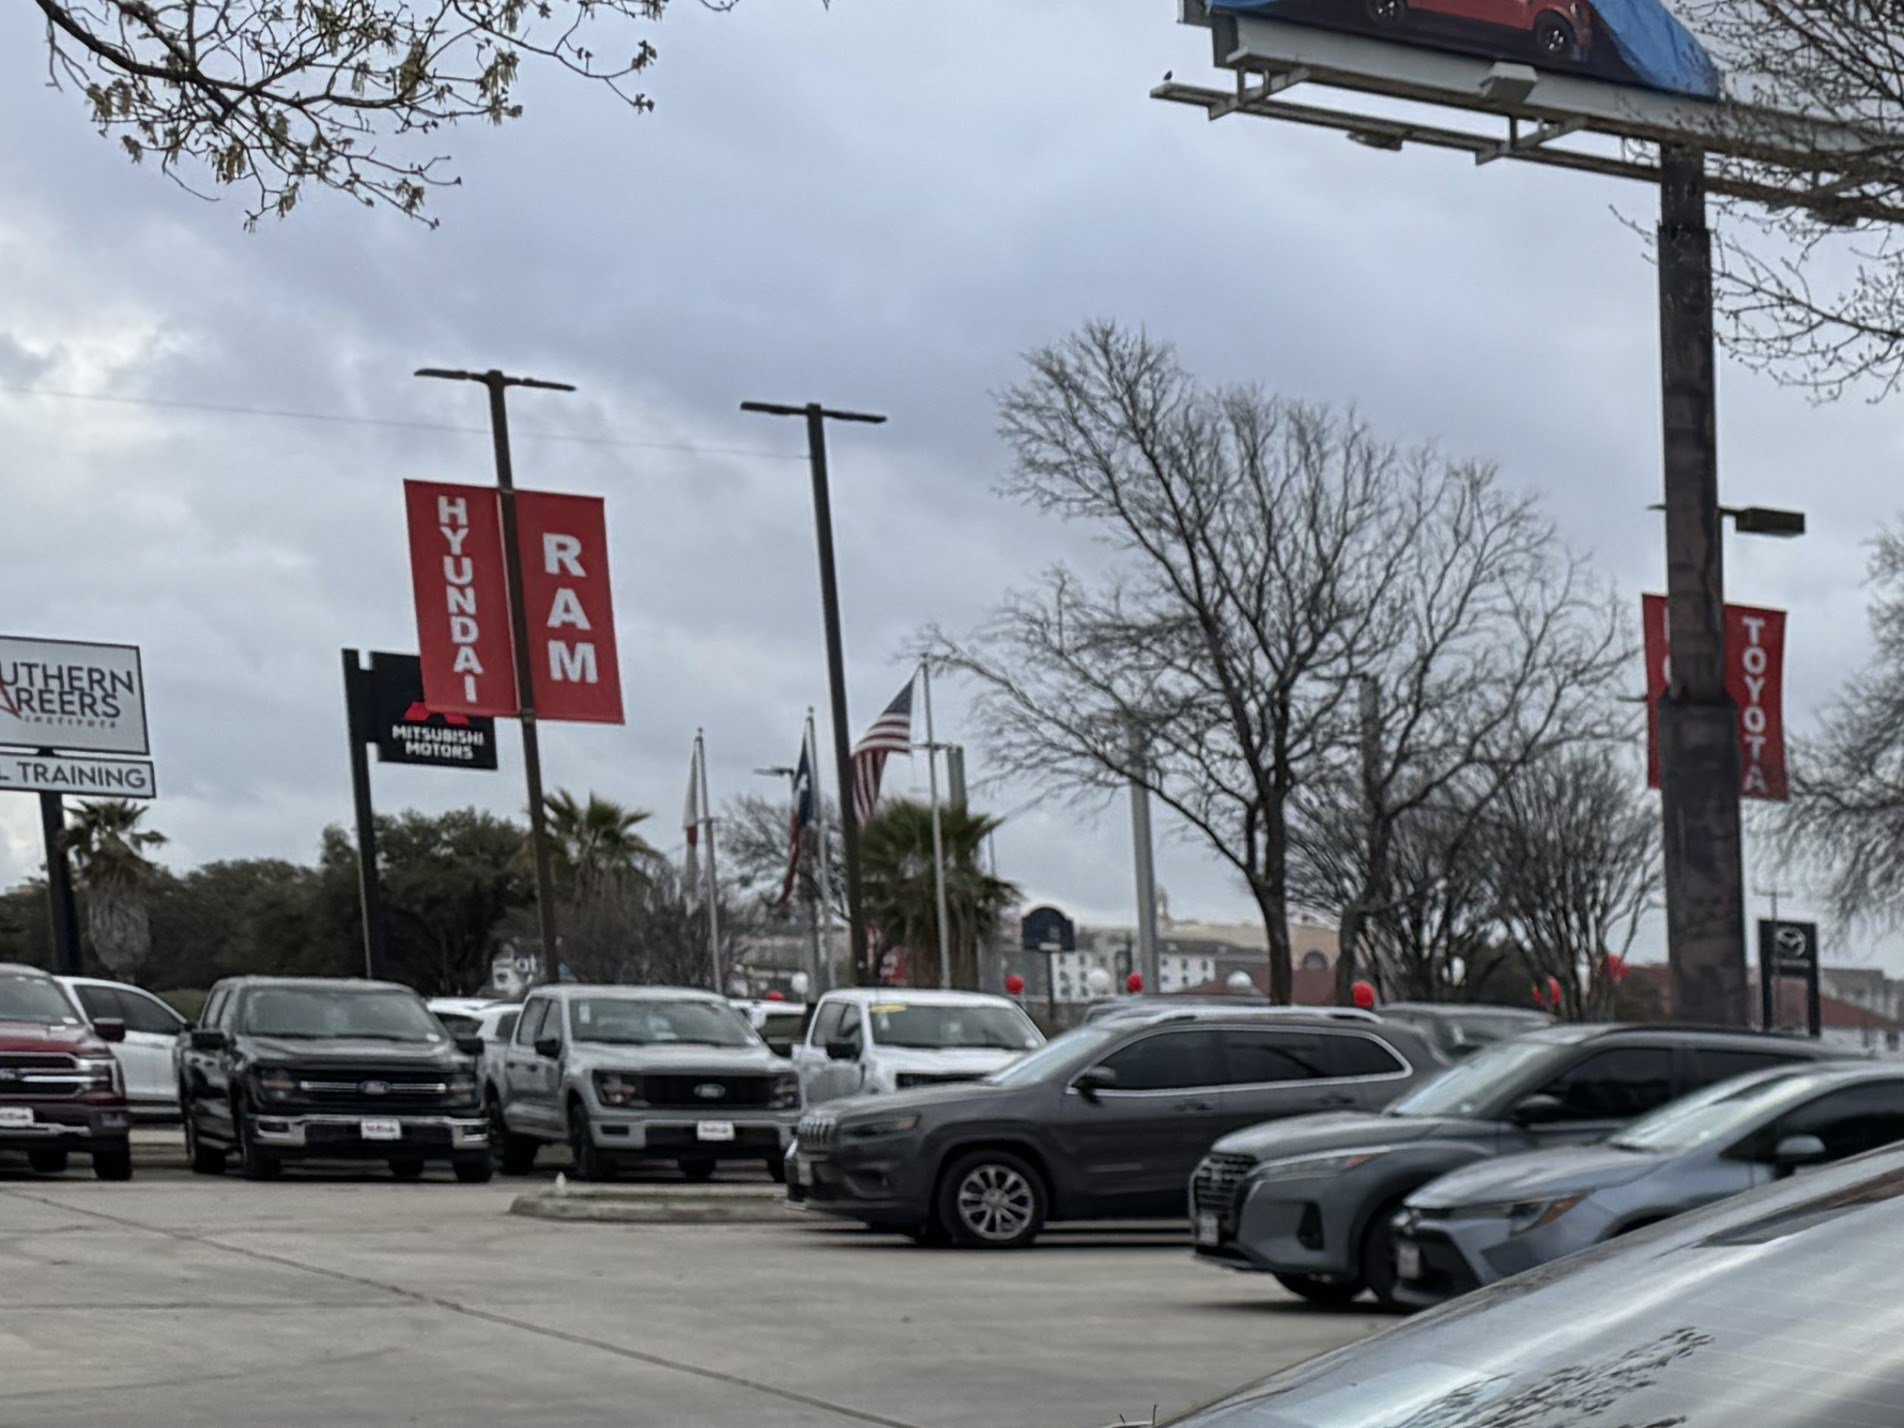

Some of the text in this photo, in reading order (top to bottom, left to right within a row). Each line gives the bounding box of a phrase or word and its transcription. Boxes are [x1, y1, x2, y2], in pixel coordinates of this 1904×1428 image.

[437, 496, 484, 703] HYUNDAI
[542, 532, 598, 684] RAM
[392, 725, 484, 746] MITSUBISHI
[1741, 615, 1767, 793] TOYOTA
[17, 761, 146, 789] TRAINING
[405, 741, 473, 759] MOTORS
